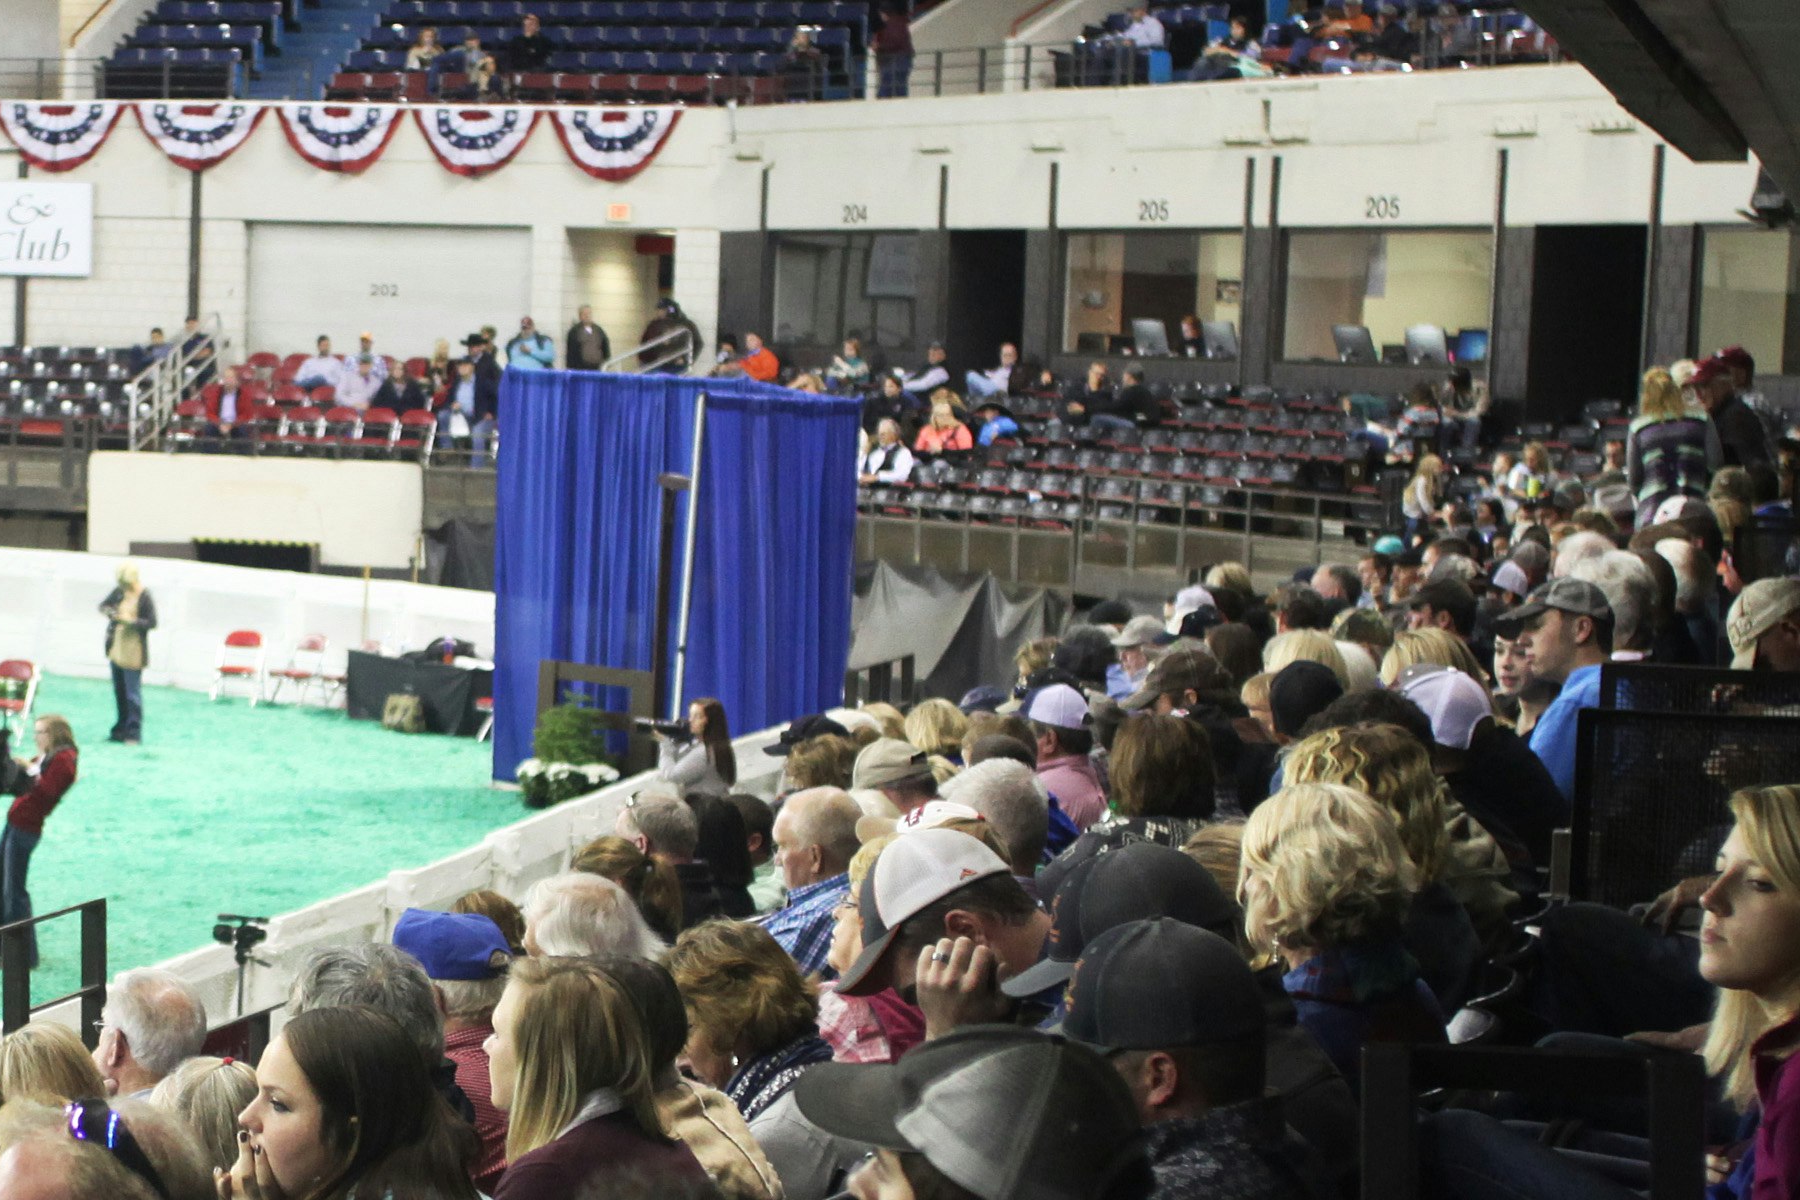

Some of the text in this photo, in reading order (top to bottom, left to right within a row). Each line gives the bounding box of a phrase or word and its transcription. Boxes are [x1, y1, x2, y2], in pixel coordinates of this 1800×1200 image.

[7, 193, 54, 225] &
[842, 204, 868, 224] 204
[1138, 200, 1169, 222] 205
[1365, 196, 1400, 218] 205
[370, 284, 399, 297] 202
